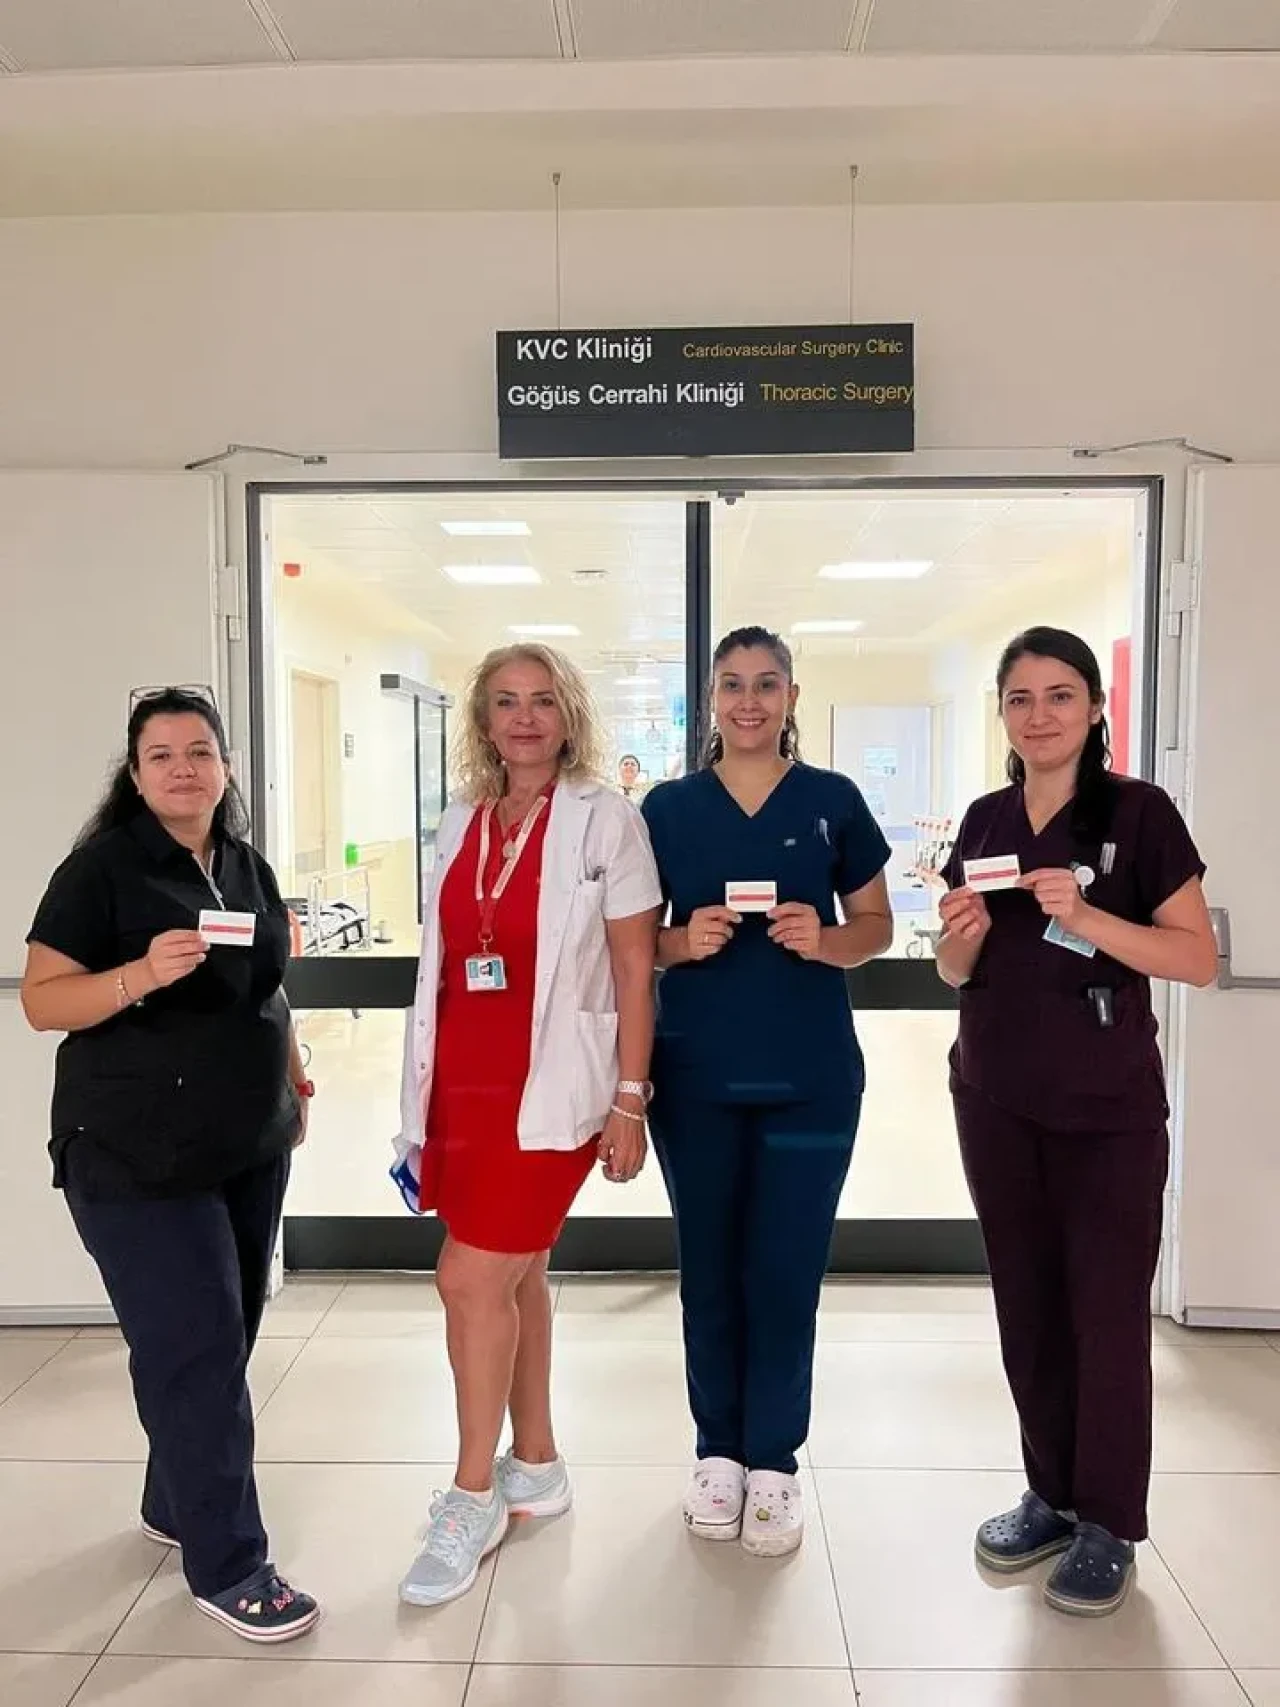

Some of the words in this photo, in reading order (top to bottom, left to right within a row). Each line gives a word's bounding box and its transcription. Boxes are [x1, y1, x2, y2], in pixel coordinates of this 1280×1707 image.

[516, 339, 567, 360] KVC
[577, 337, 652, 363] Kliniği
[683, 342, 797, 358] Cardiovascular
[801, 340, 861, 357] Surgery
[866, 338, 905, 354] Clinic
[508, 385, 580, 410] Göğüs
[590, 383, 668, 404] Cerrahi
[676, 382, 744, 408] Kliniği
[761, 383, 837, 401] Thoracic
[843, 382, 914, 405] Surgery
